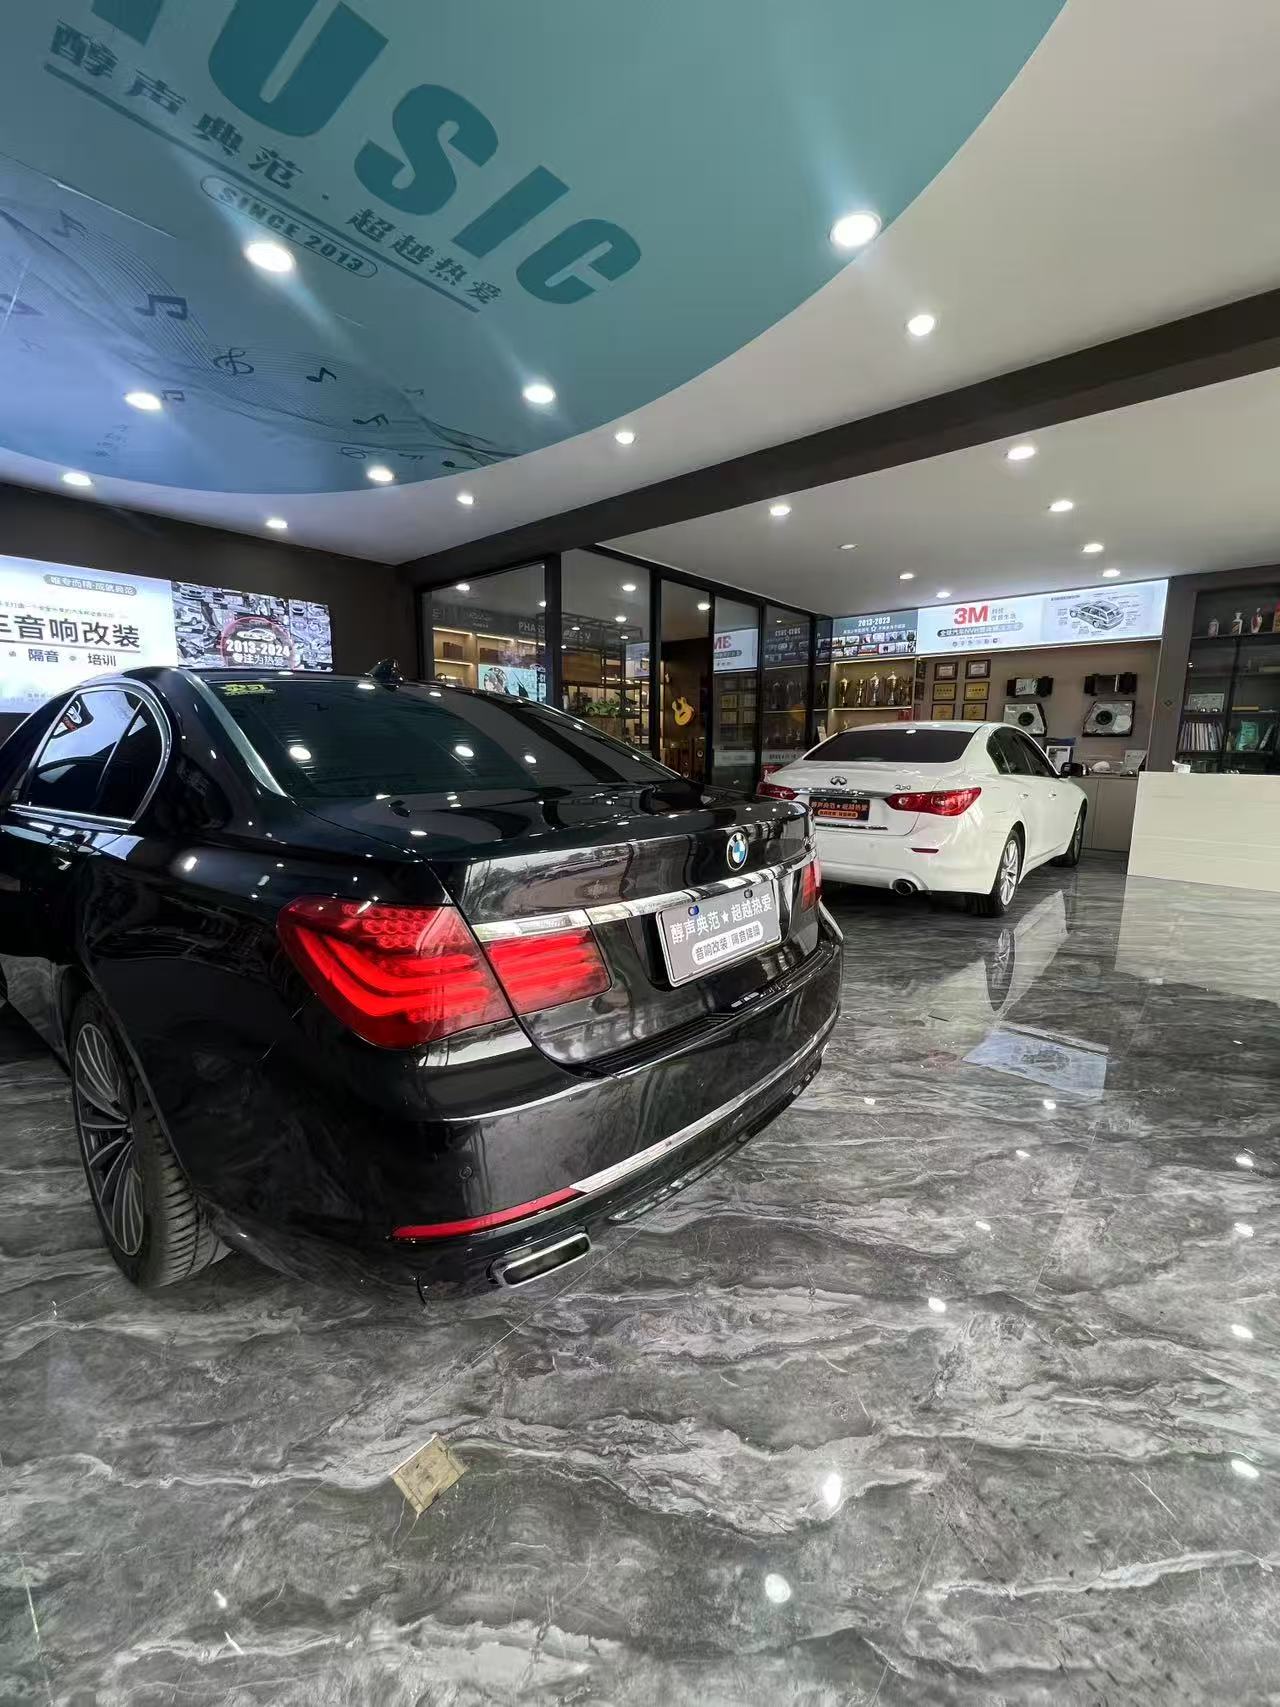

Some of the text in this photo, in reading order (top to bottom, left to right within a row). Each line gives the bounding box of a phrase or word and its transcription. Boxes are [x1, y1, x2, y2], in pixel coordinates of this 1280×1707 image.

[219, 187, 363, 271] SINCE 2013
[857, 616, 891, 627] 2013-2023
[953, 605, 988, 624] 3M
[28, 648, 117, 667] 隔音 培训
[226, 639, 290, 657] 2013-2024
[669, 894, 773, 945] 醇声典范 超越热爱
